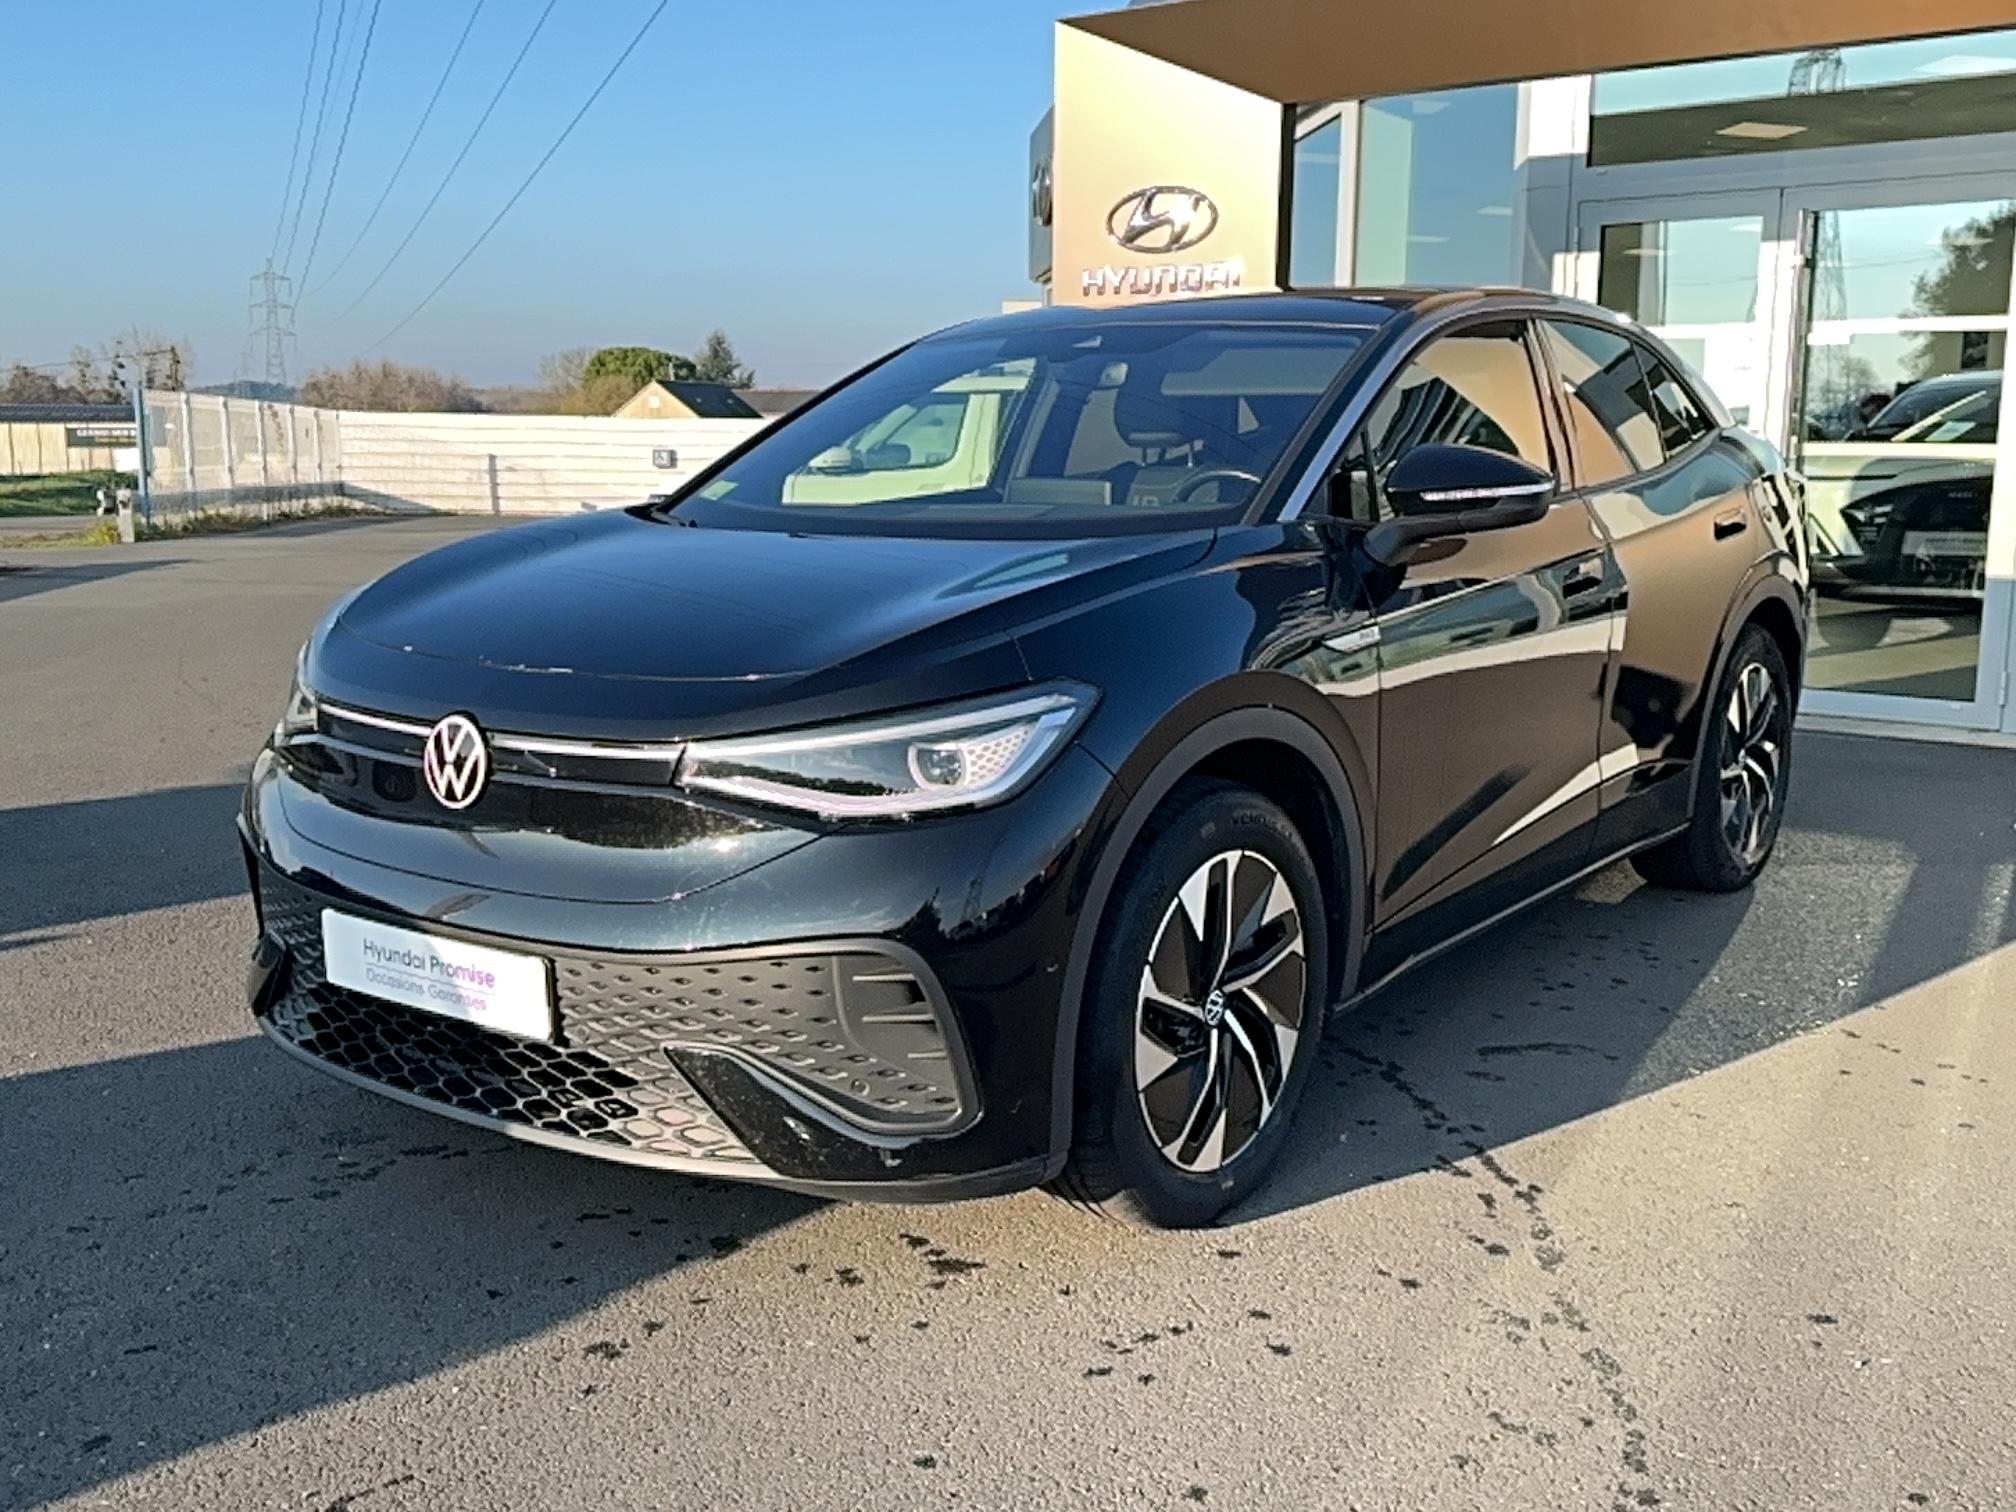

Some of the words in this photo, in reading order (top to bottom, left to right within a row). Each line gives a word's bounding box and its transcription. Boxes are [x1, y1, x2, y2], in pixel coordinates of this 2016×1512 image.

[1082, 263, 1241, 296] HYUNDAI
[363, 939, 426, 972] Hyundai
[430, 955, 496, 988] Promise
